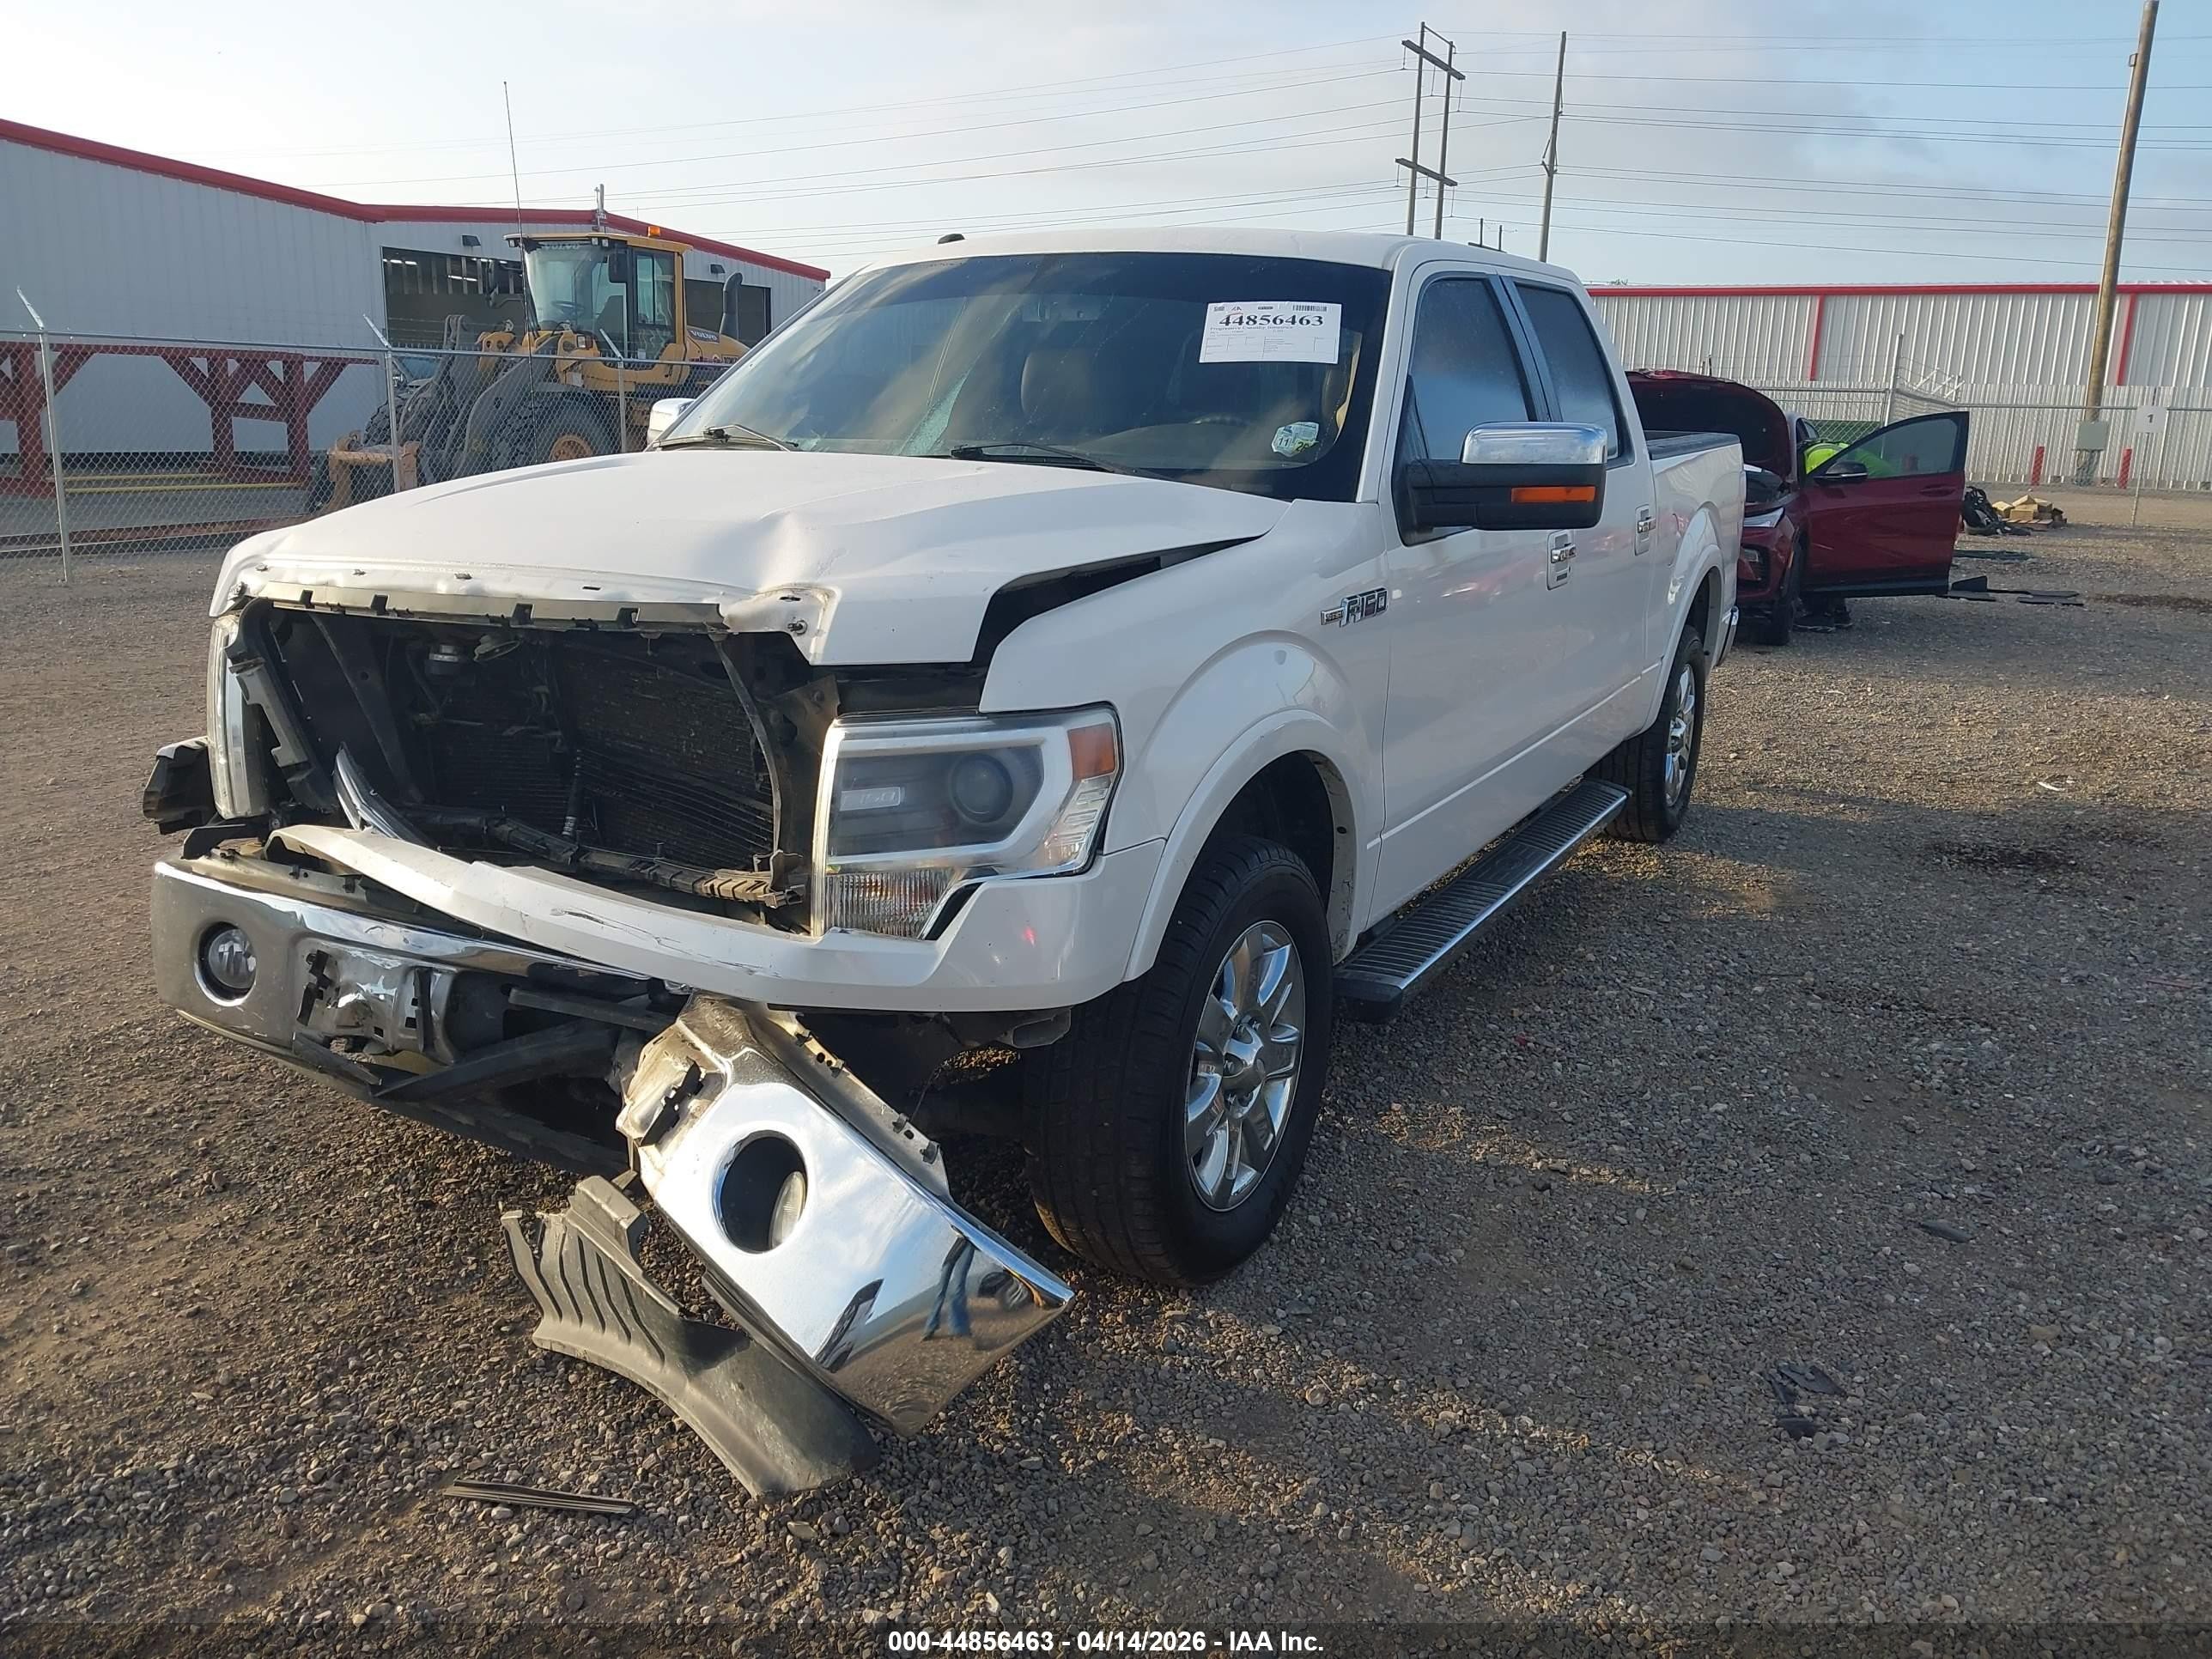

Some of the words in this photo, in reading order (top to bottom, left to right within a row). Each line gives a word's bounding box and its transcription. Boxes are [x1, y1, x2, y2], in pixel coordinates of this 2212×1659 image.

[1218, 314, 1324, 326] 44856463
[690, 330, 718, 341] VOLVO
[2147, 414, 2154, 423] 1
[1279, 437, 1290, 447] 11
